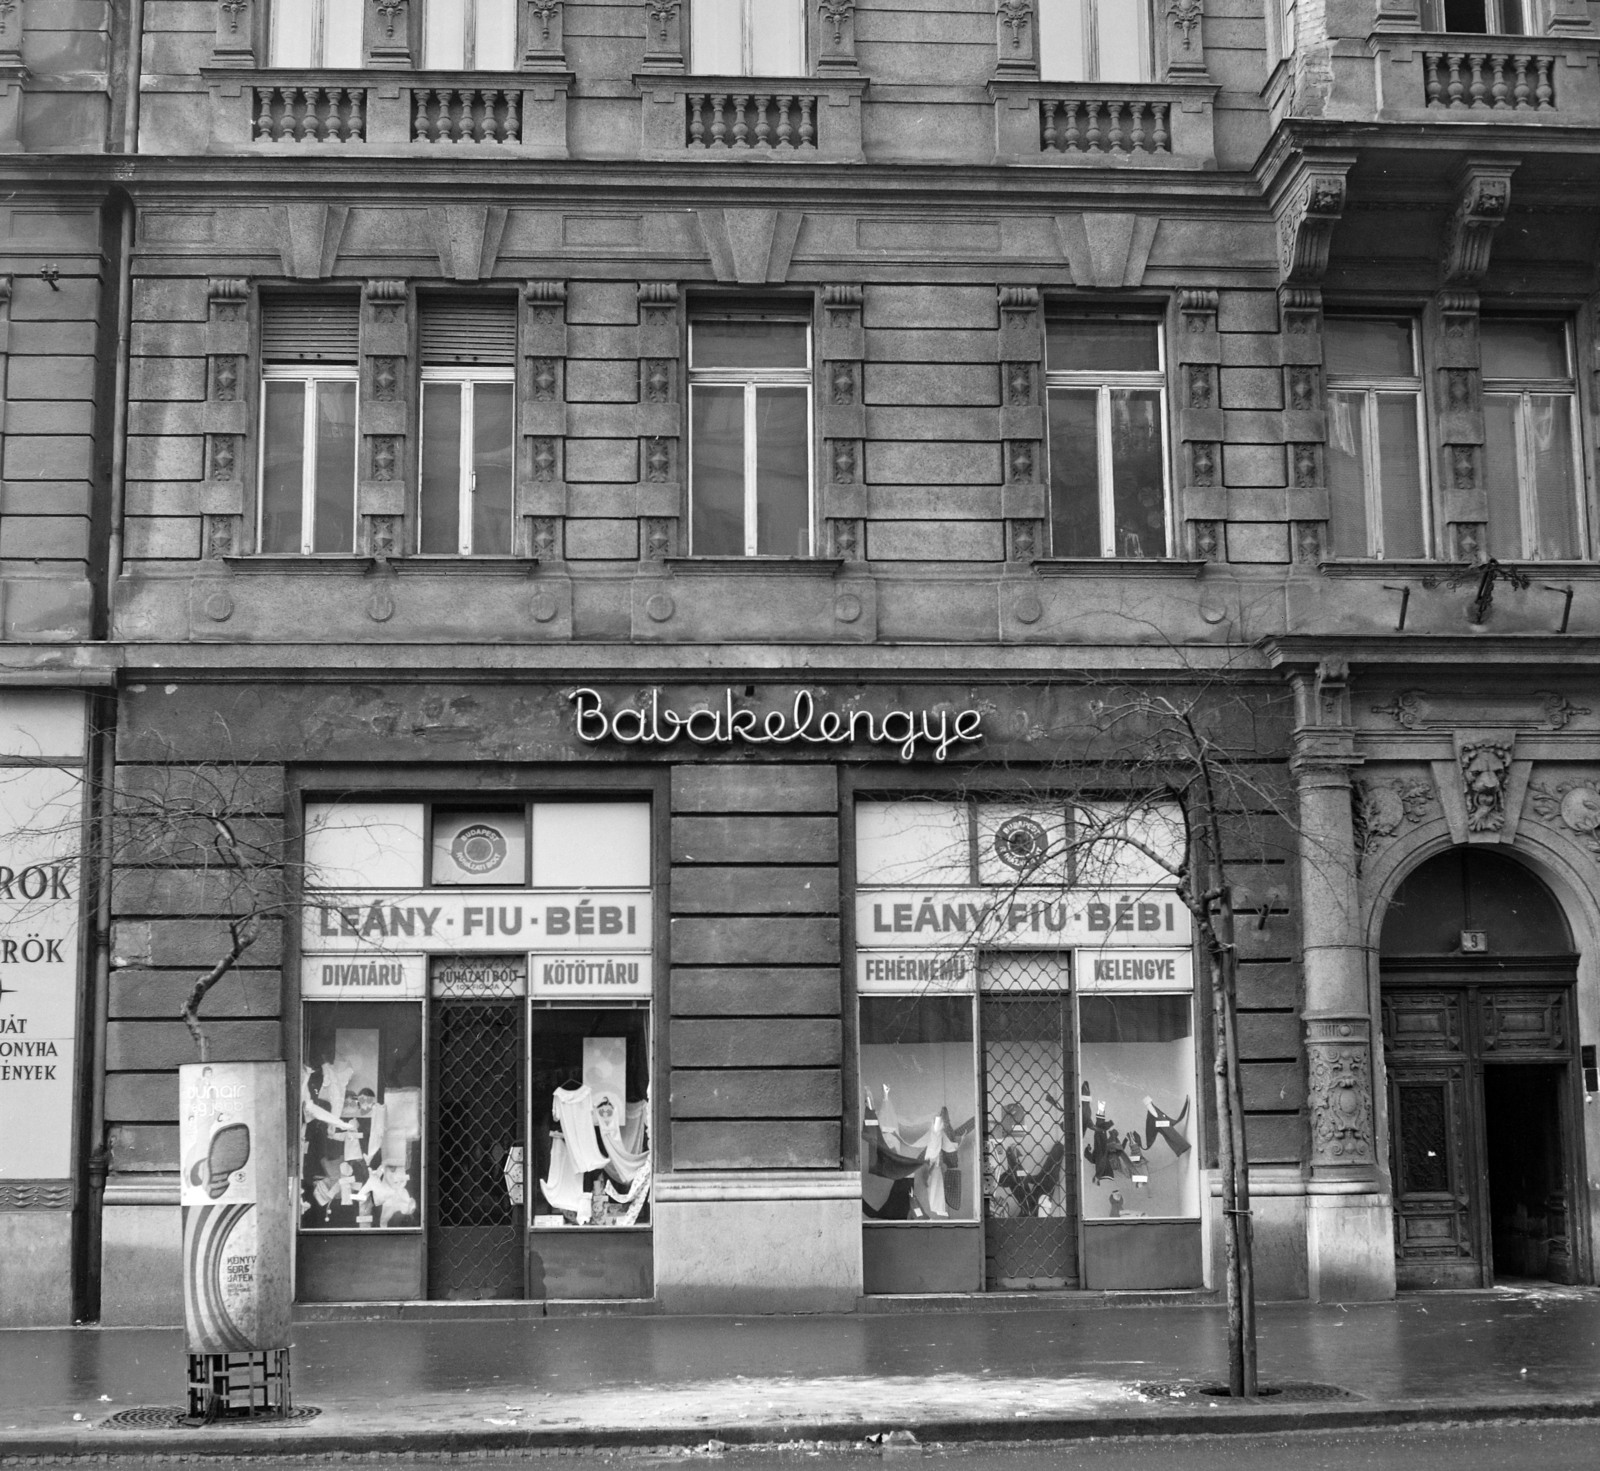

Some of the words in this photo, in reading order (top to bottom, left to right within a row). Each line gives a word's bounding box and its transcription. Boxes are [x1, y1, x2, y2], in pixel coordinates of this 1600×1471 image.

[569, 688, 983, 761] Babakelengye
[460, 829, 500, 841] BUDAPEST
[320, 899, 442, 937] LEÁNY
[463, 906, 522, 936] FIU
[546, 899, 635, 935] BÉBI
[874, 896, 991, 933] LEÁNY
[1008, 903, 1066, 932] FIU
[1088, 895, 1174, 931] BÉBI
[1, 932, 64, 964] RÖK
[322, 961, 403, 986] DIVATÁRU
[543, 959, 638, 985] KÖTÖTTÁRU
[1094, 959, 1175, 980] KELENGYE
